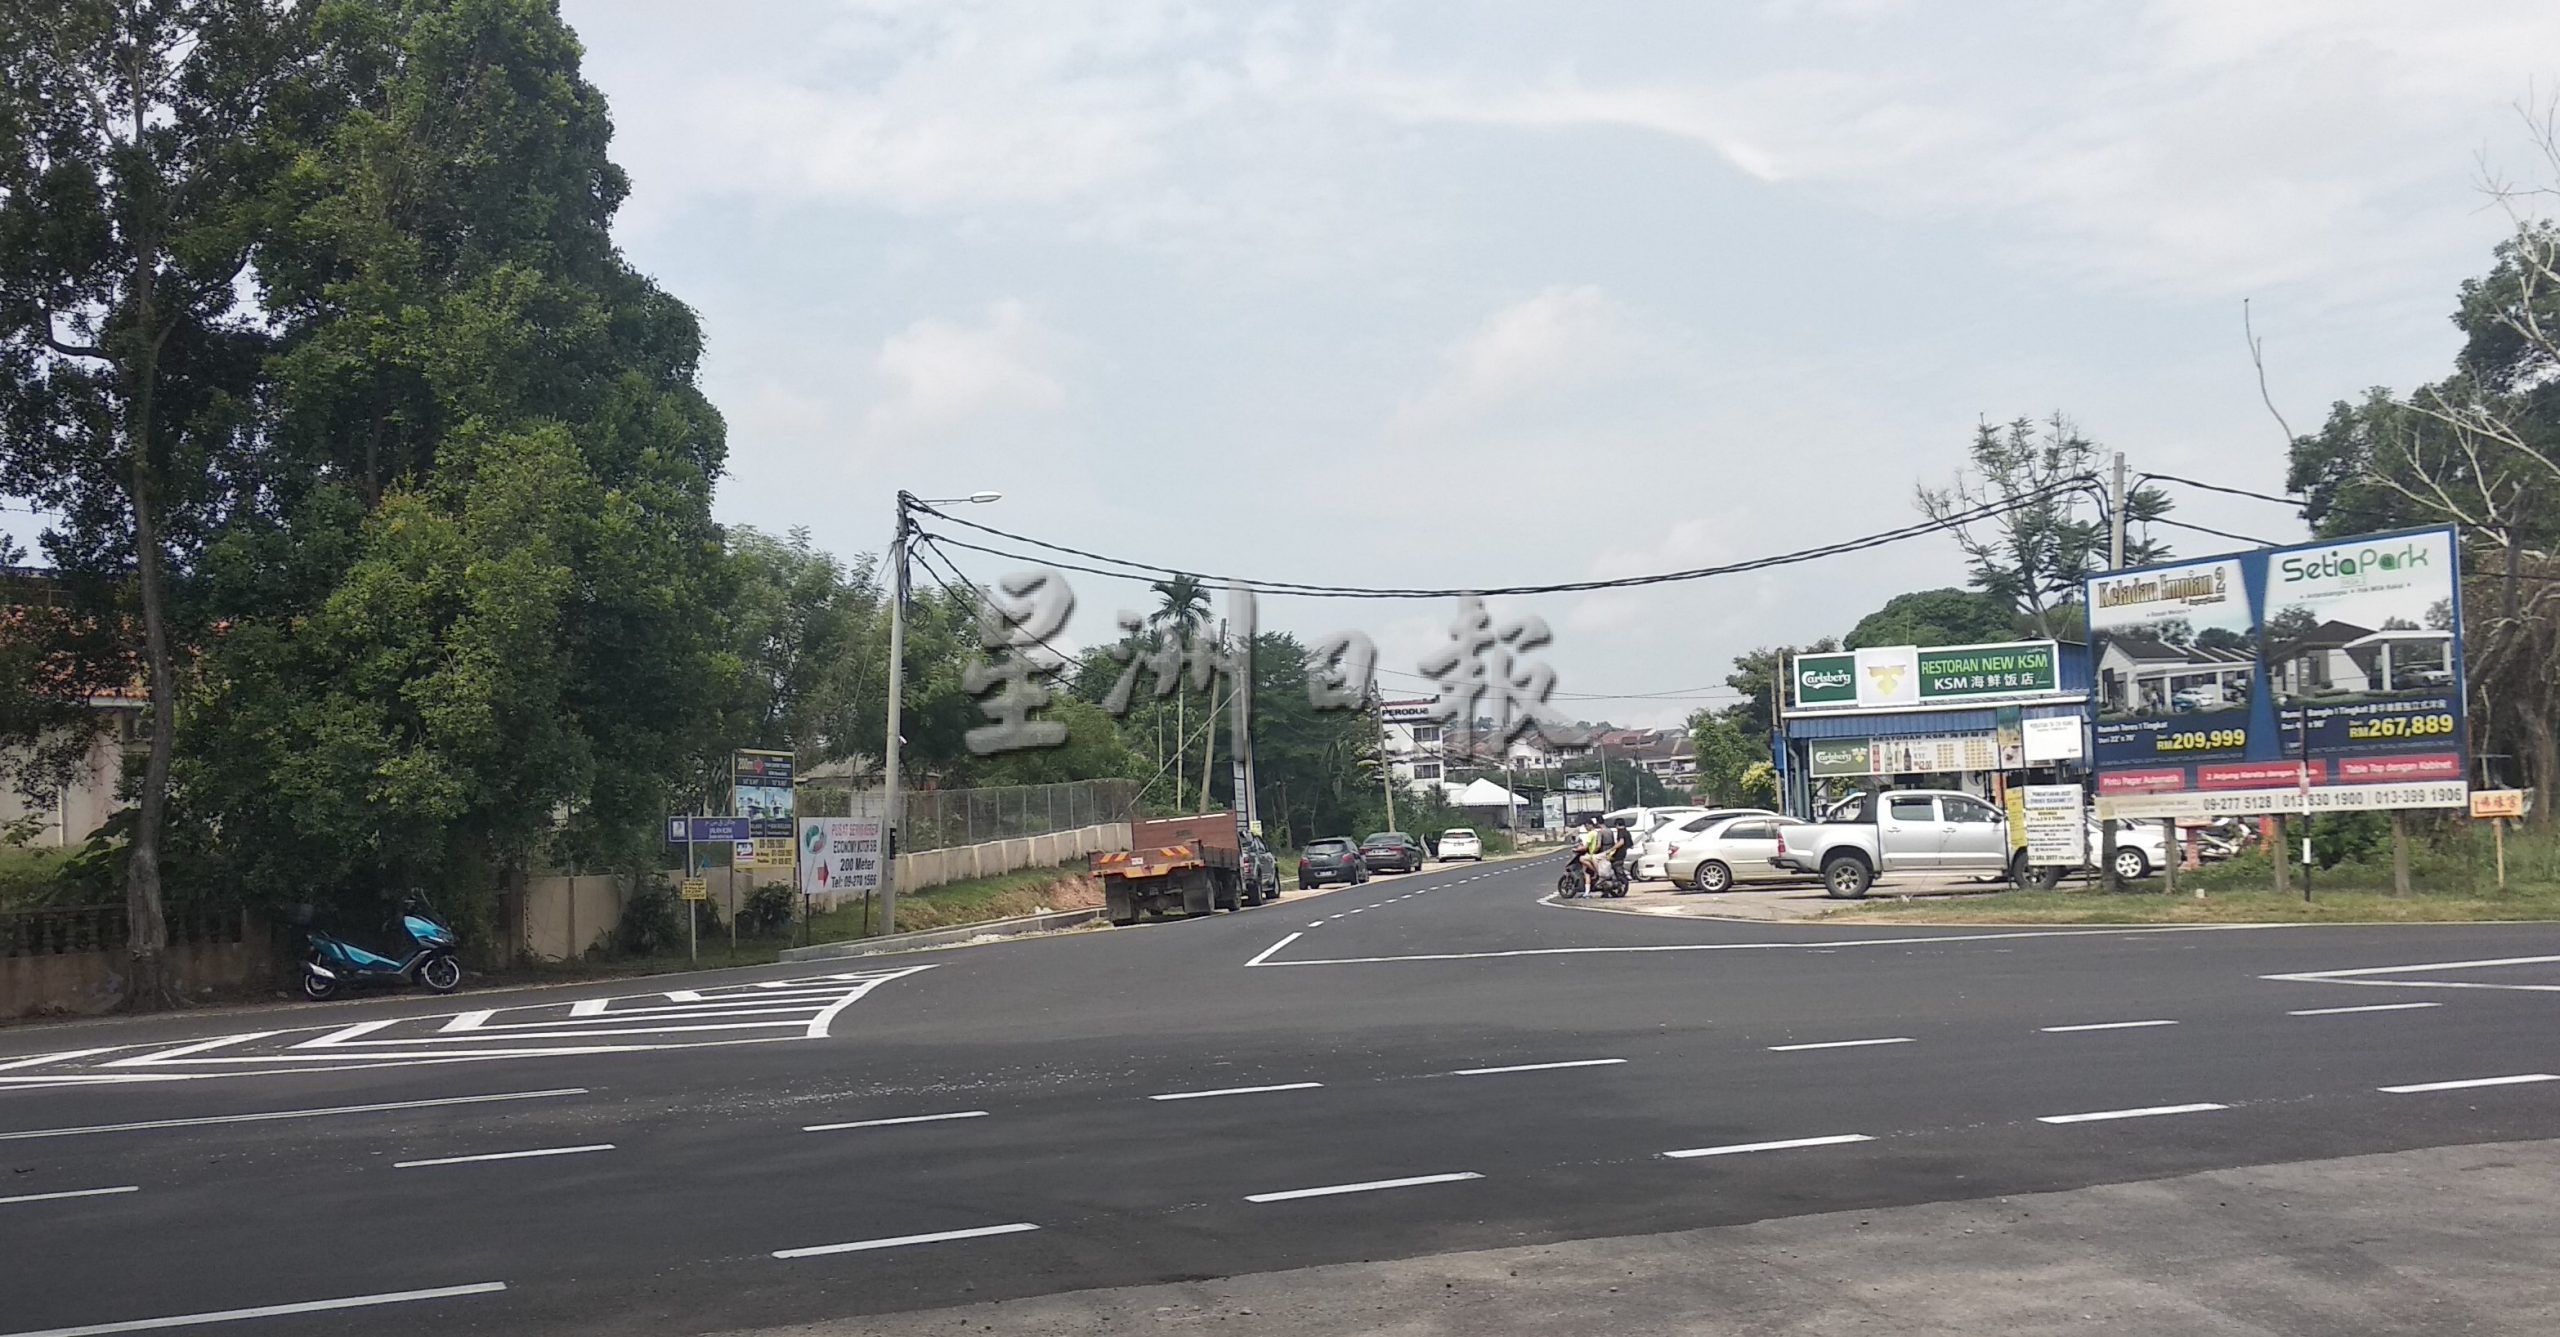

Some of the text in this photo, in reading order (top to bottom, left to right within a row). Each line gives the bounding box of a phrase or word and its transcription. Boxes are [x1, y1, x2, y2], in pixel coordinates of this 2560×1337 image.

[2215, 566, 2226, 594] 2
[1921, 654, 2048, 675] RESTORAN NEW KSM
[1801, 669, 1851, 689] Carlsberg
[1934, 672, 2034, 690] KSM 海鲜饭店
[2349, 714, 2453, 738] RM267,889
[2156, 728, 2246, 750] RM209,999
[1815, 751, 1852, 765] Carlsberg
[2203, 797, 2240, 811] 09-277
[2244, 796, 2272, 808] 5128
[2334, 791, 2364, 805] 1900
[2375, 787, 2462, 804] 013-399 1906
[833, 840, 857, 853] ECONOMY
[840, 857, 875, 871] 200 Meter
